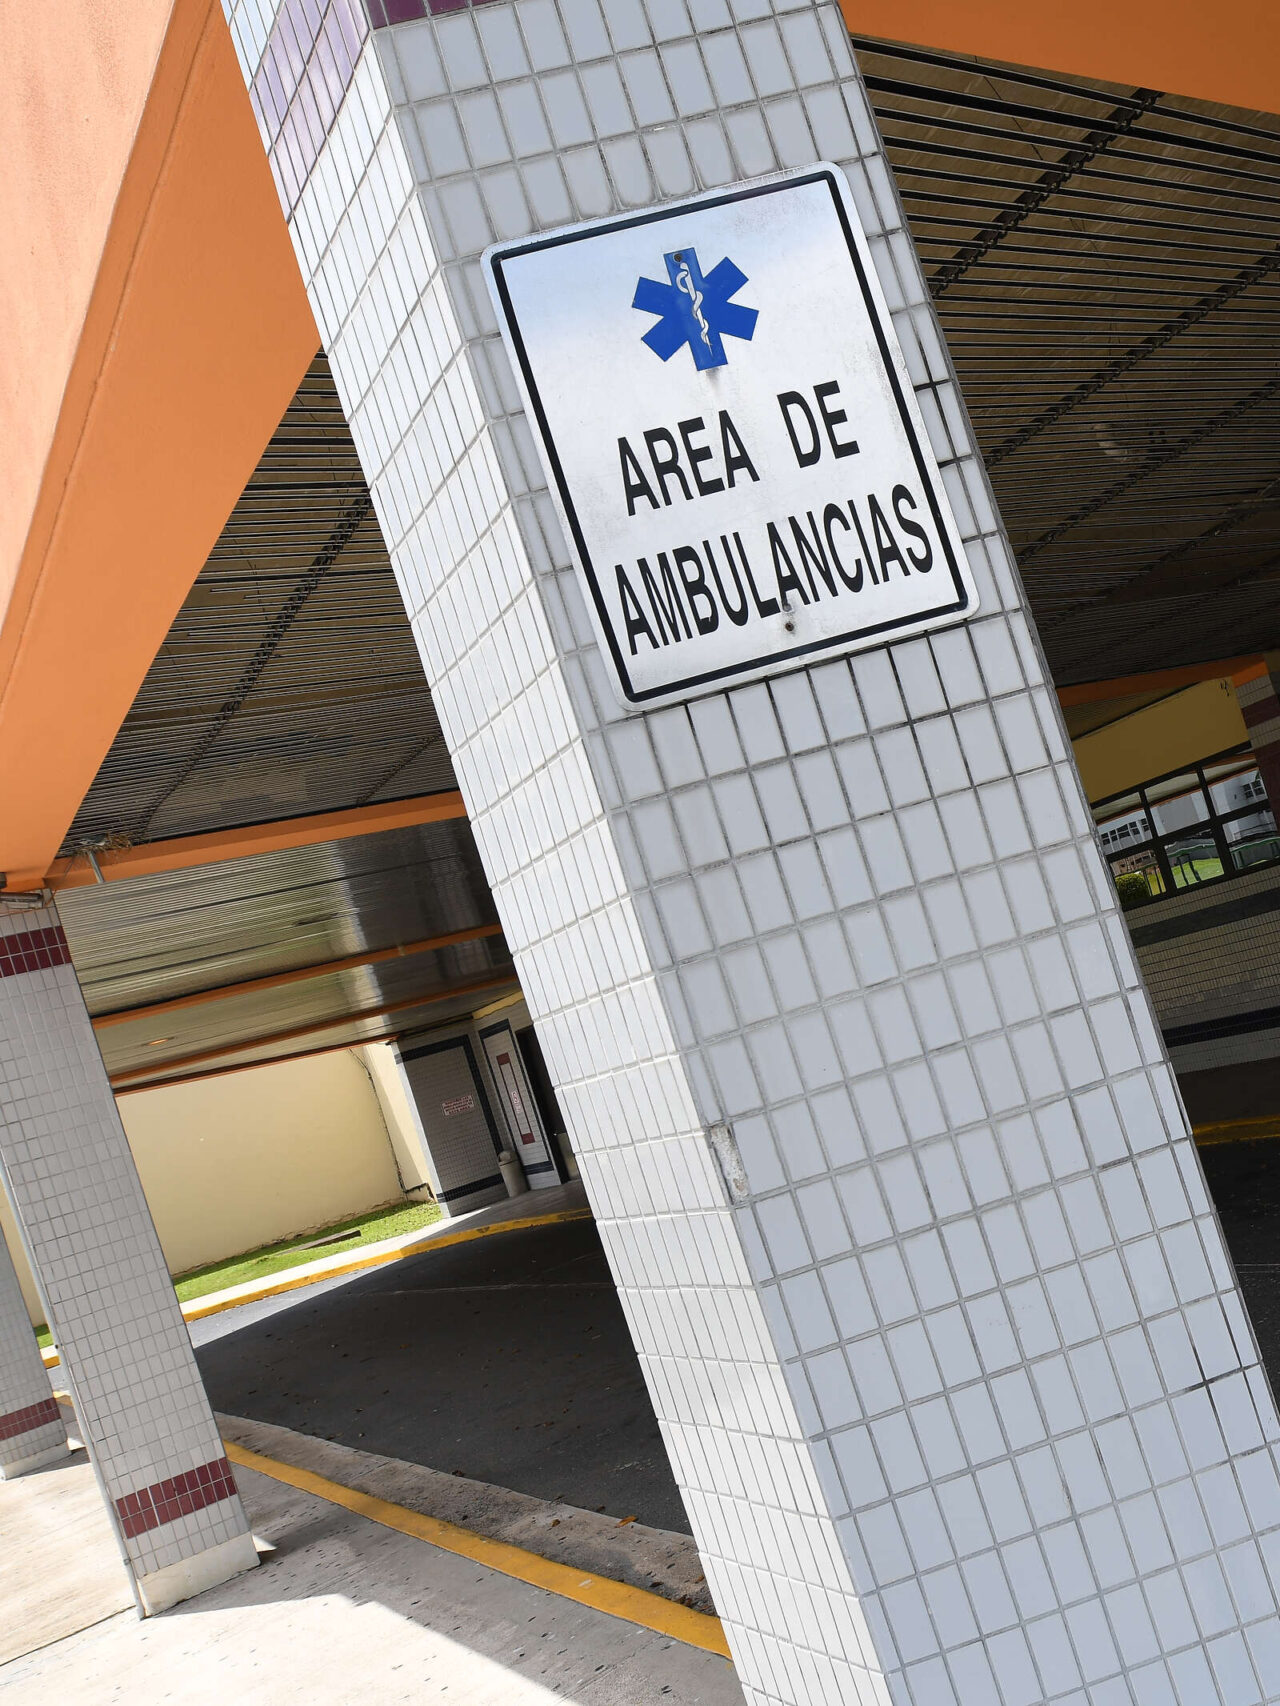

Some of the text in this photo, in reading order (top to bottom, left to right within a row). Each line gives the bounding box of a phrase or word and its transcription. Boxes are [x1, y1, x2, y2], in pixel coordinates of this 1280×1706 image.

[617, 381, 860, 516] AREA DE
[615, 484, 933, 656] AMBULANCIAS
